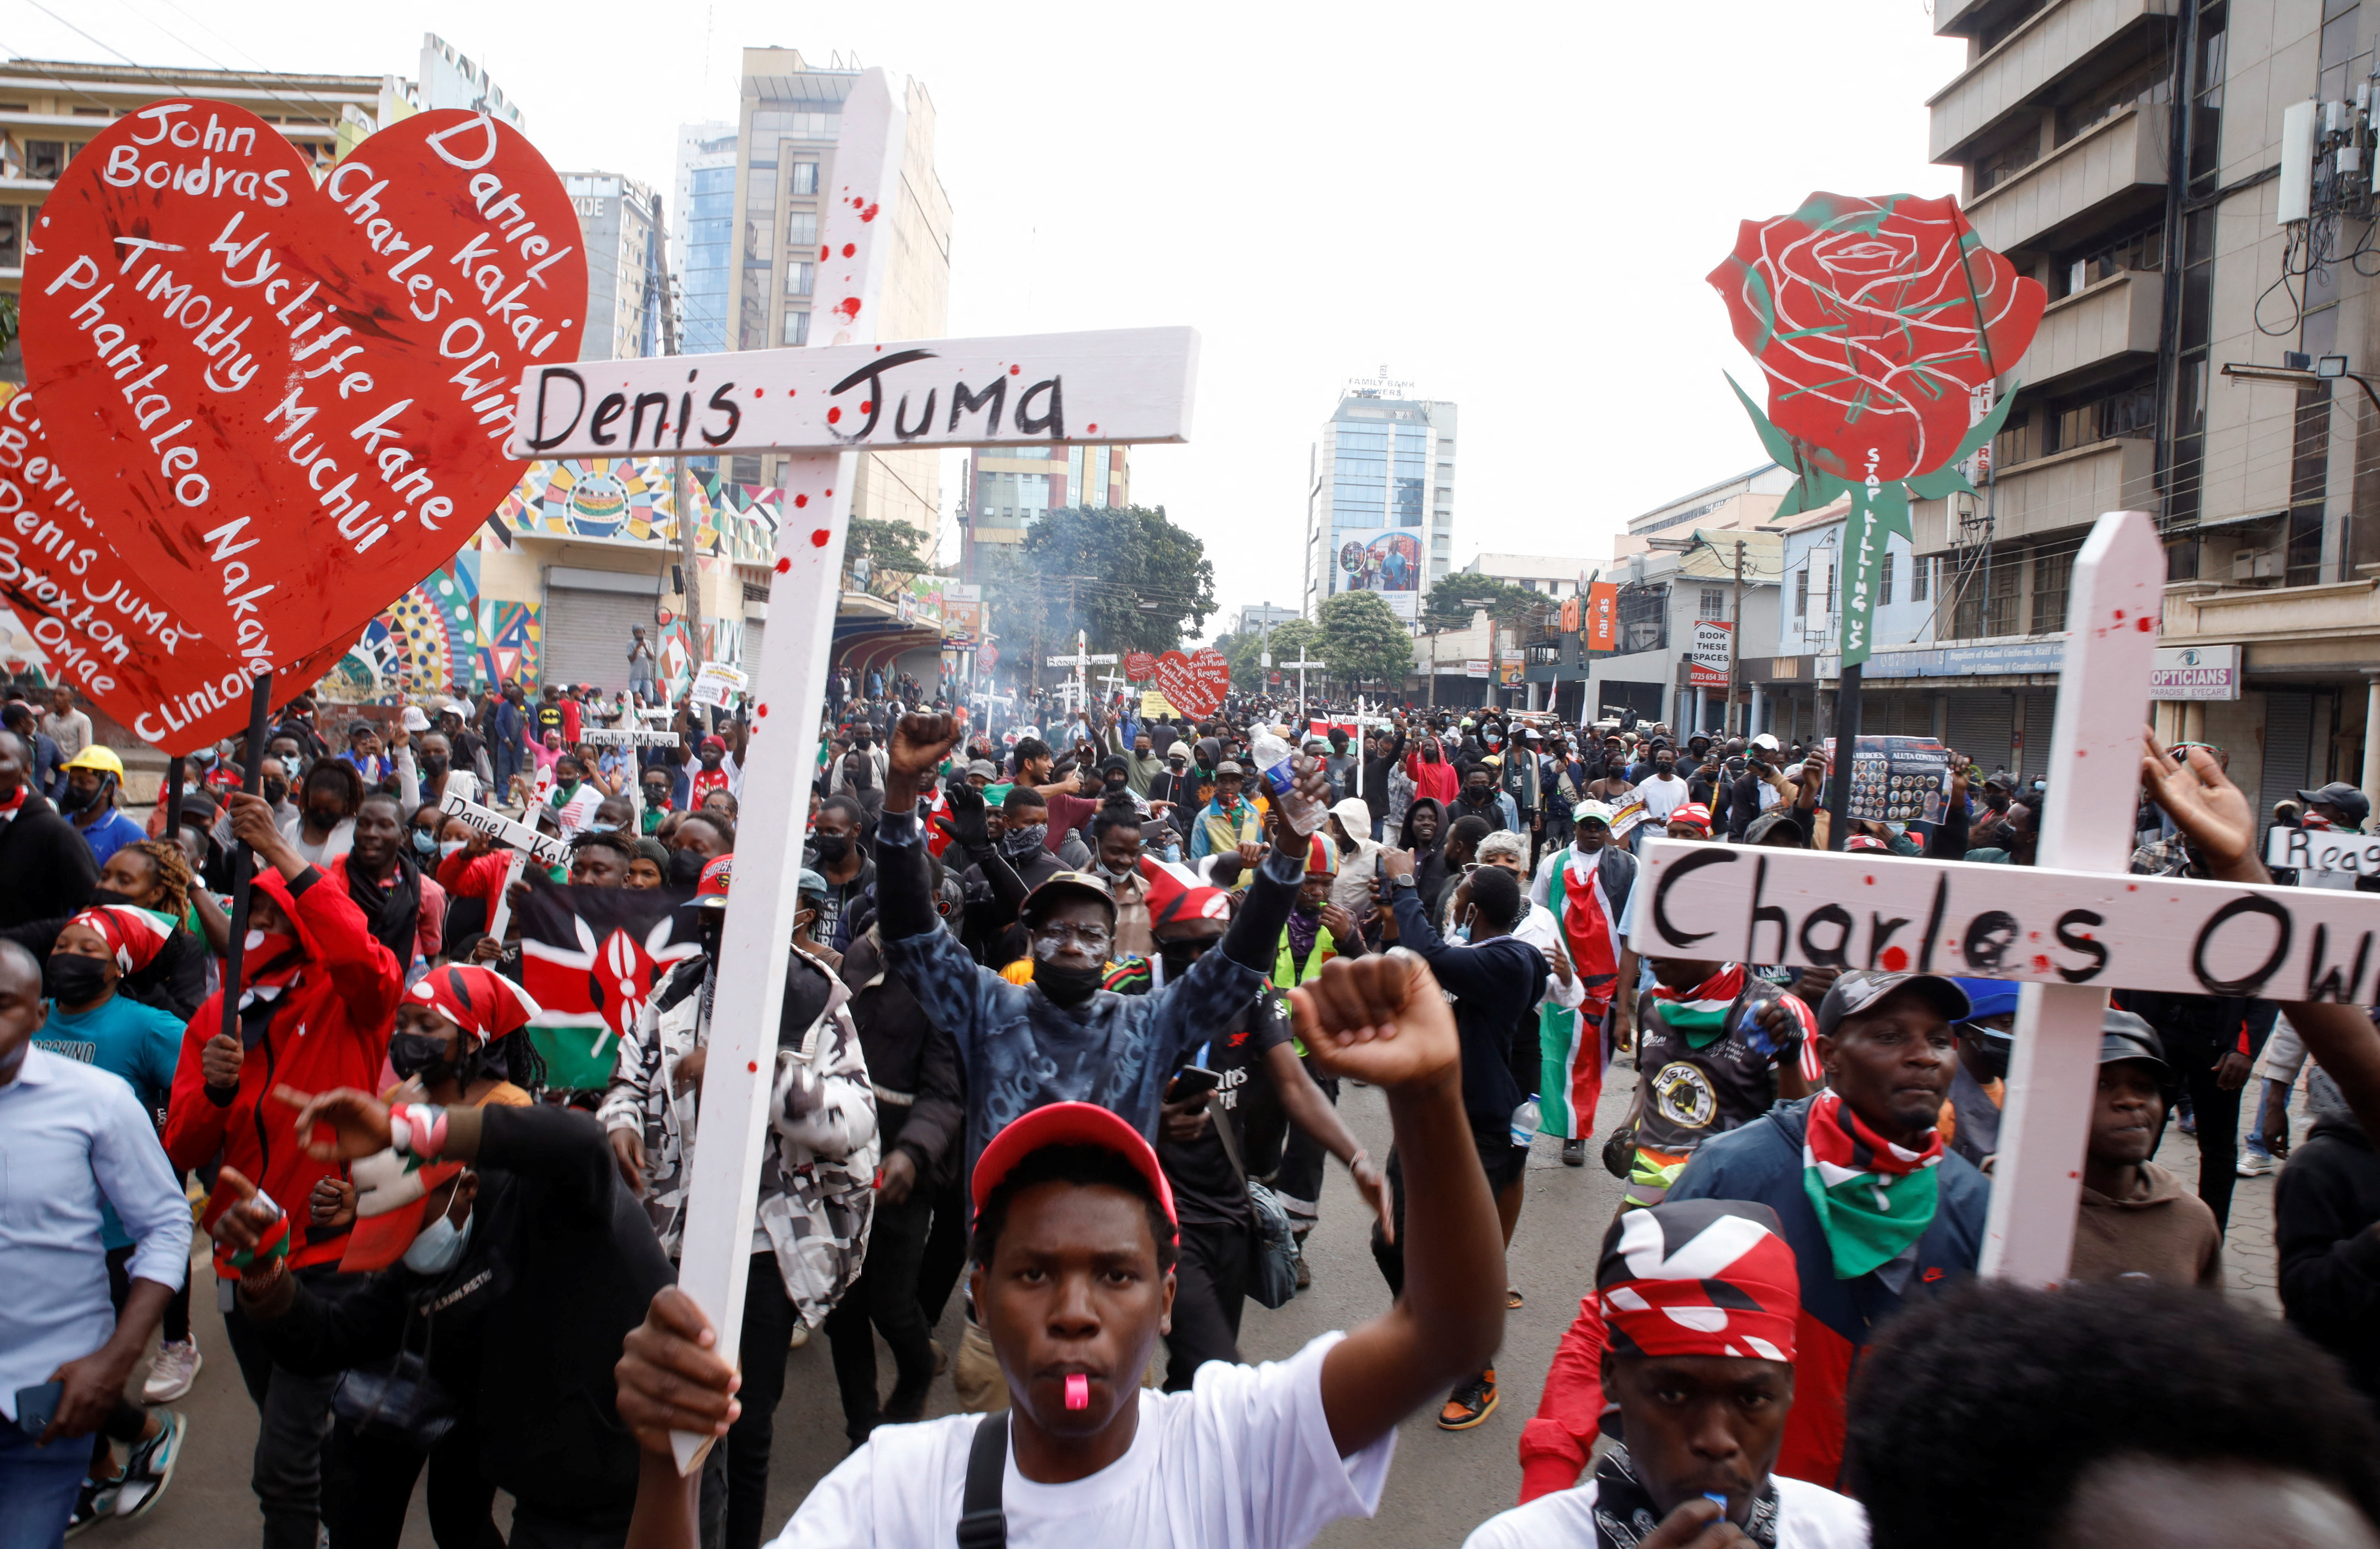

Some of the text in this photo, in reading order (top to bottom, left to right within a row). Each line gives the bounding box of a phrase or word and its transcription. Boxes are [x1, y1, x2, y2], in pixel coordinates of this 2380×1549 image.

[131, 104, 256, 156] John
[328, 162, 453, 322] Charles
[526, 368, 742, 451] Denis
[1848, 448, 1881, 649] STOP KILLING US
[1187, 660, 1206, 669] John
[1693, 653, 1729, 662] SPACES
[1950, 652, 1975, 661] Suppliers
[1976, 650, 1983, 658] of
[1983, 649, 2002, 658] School
[2035, 646, 2051, 656] Staff
[1977, 663, 2003, 672] Uniforms
[2012, 661, 2046, 671] Graduation
[1197, 668, 1221, 679] Reagan
[2151, 669, 2227, 685] OPTICIANS
[447, 797, 508, 839] Daniel
[1652, 848, 2108, 985] Charles
[1656, 1067, 1706, 1094] TUSKER
